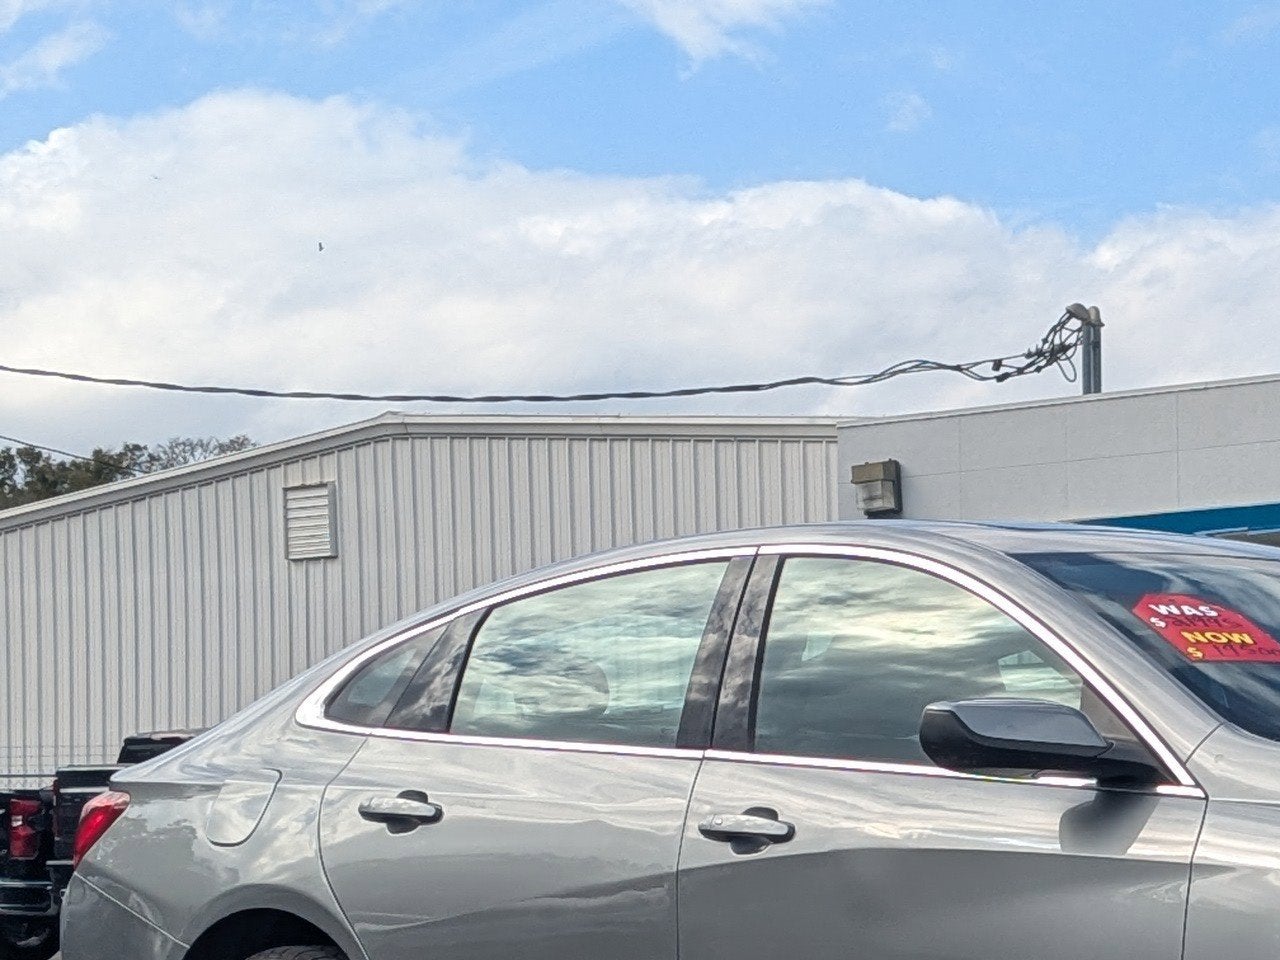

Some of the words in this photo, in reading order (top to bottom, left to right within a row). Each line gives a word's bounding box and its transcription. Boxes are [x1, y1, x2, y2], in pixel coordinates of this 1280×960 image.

[1149, 604, 1219, 617] WAS
[1150, 616, 1166, 628] $
[1181, 631, 1256, 645] NOW
[1186, 646, 1204, 659] $
